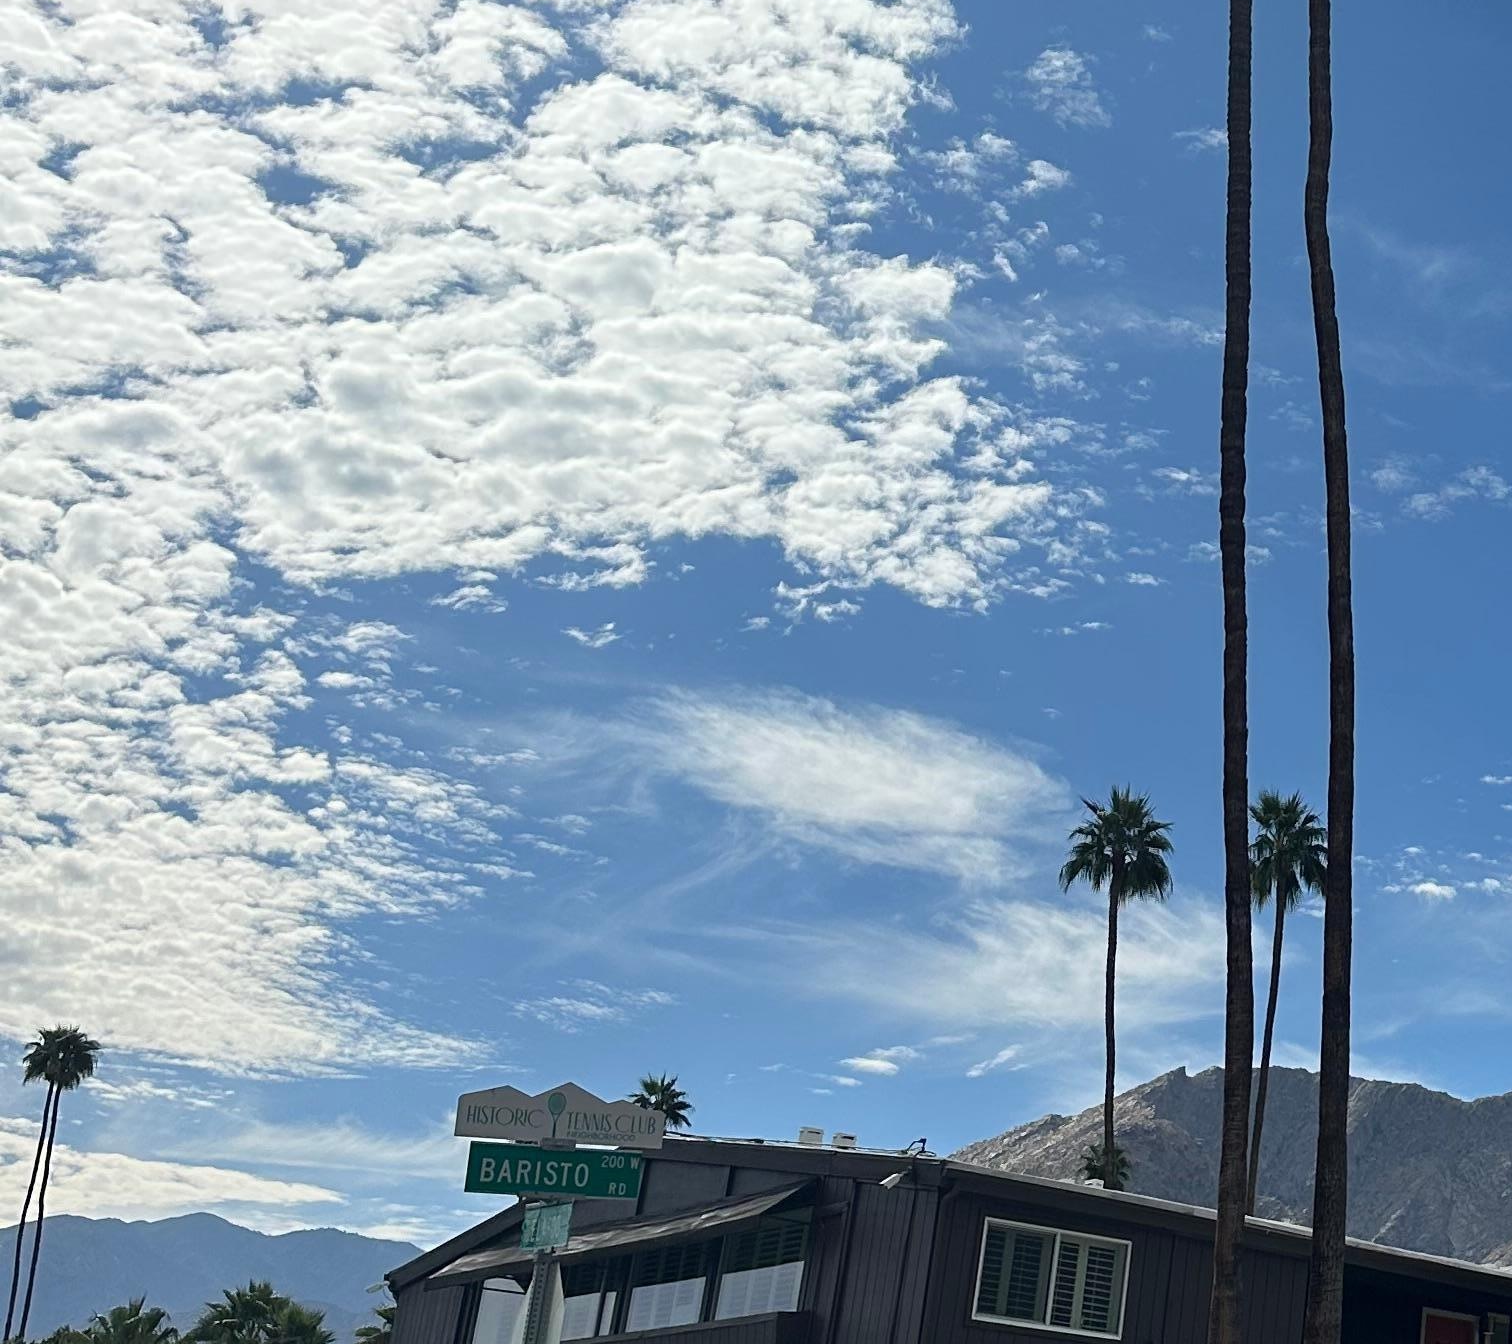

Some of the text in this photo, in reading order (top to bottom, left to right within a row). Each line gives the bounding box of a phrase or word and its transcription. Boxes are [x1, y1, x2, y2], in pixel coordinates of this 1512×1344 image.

[466, 1104, 656, 1135] HISTORIC TENNIS CLUB
[479, 1157, 590, 1188] BARISTO
[601, 1155, 641, 1170] 200 W
[608, 1182, 627, 1196] RD
